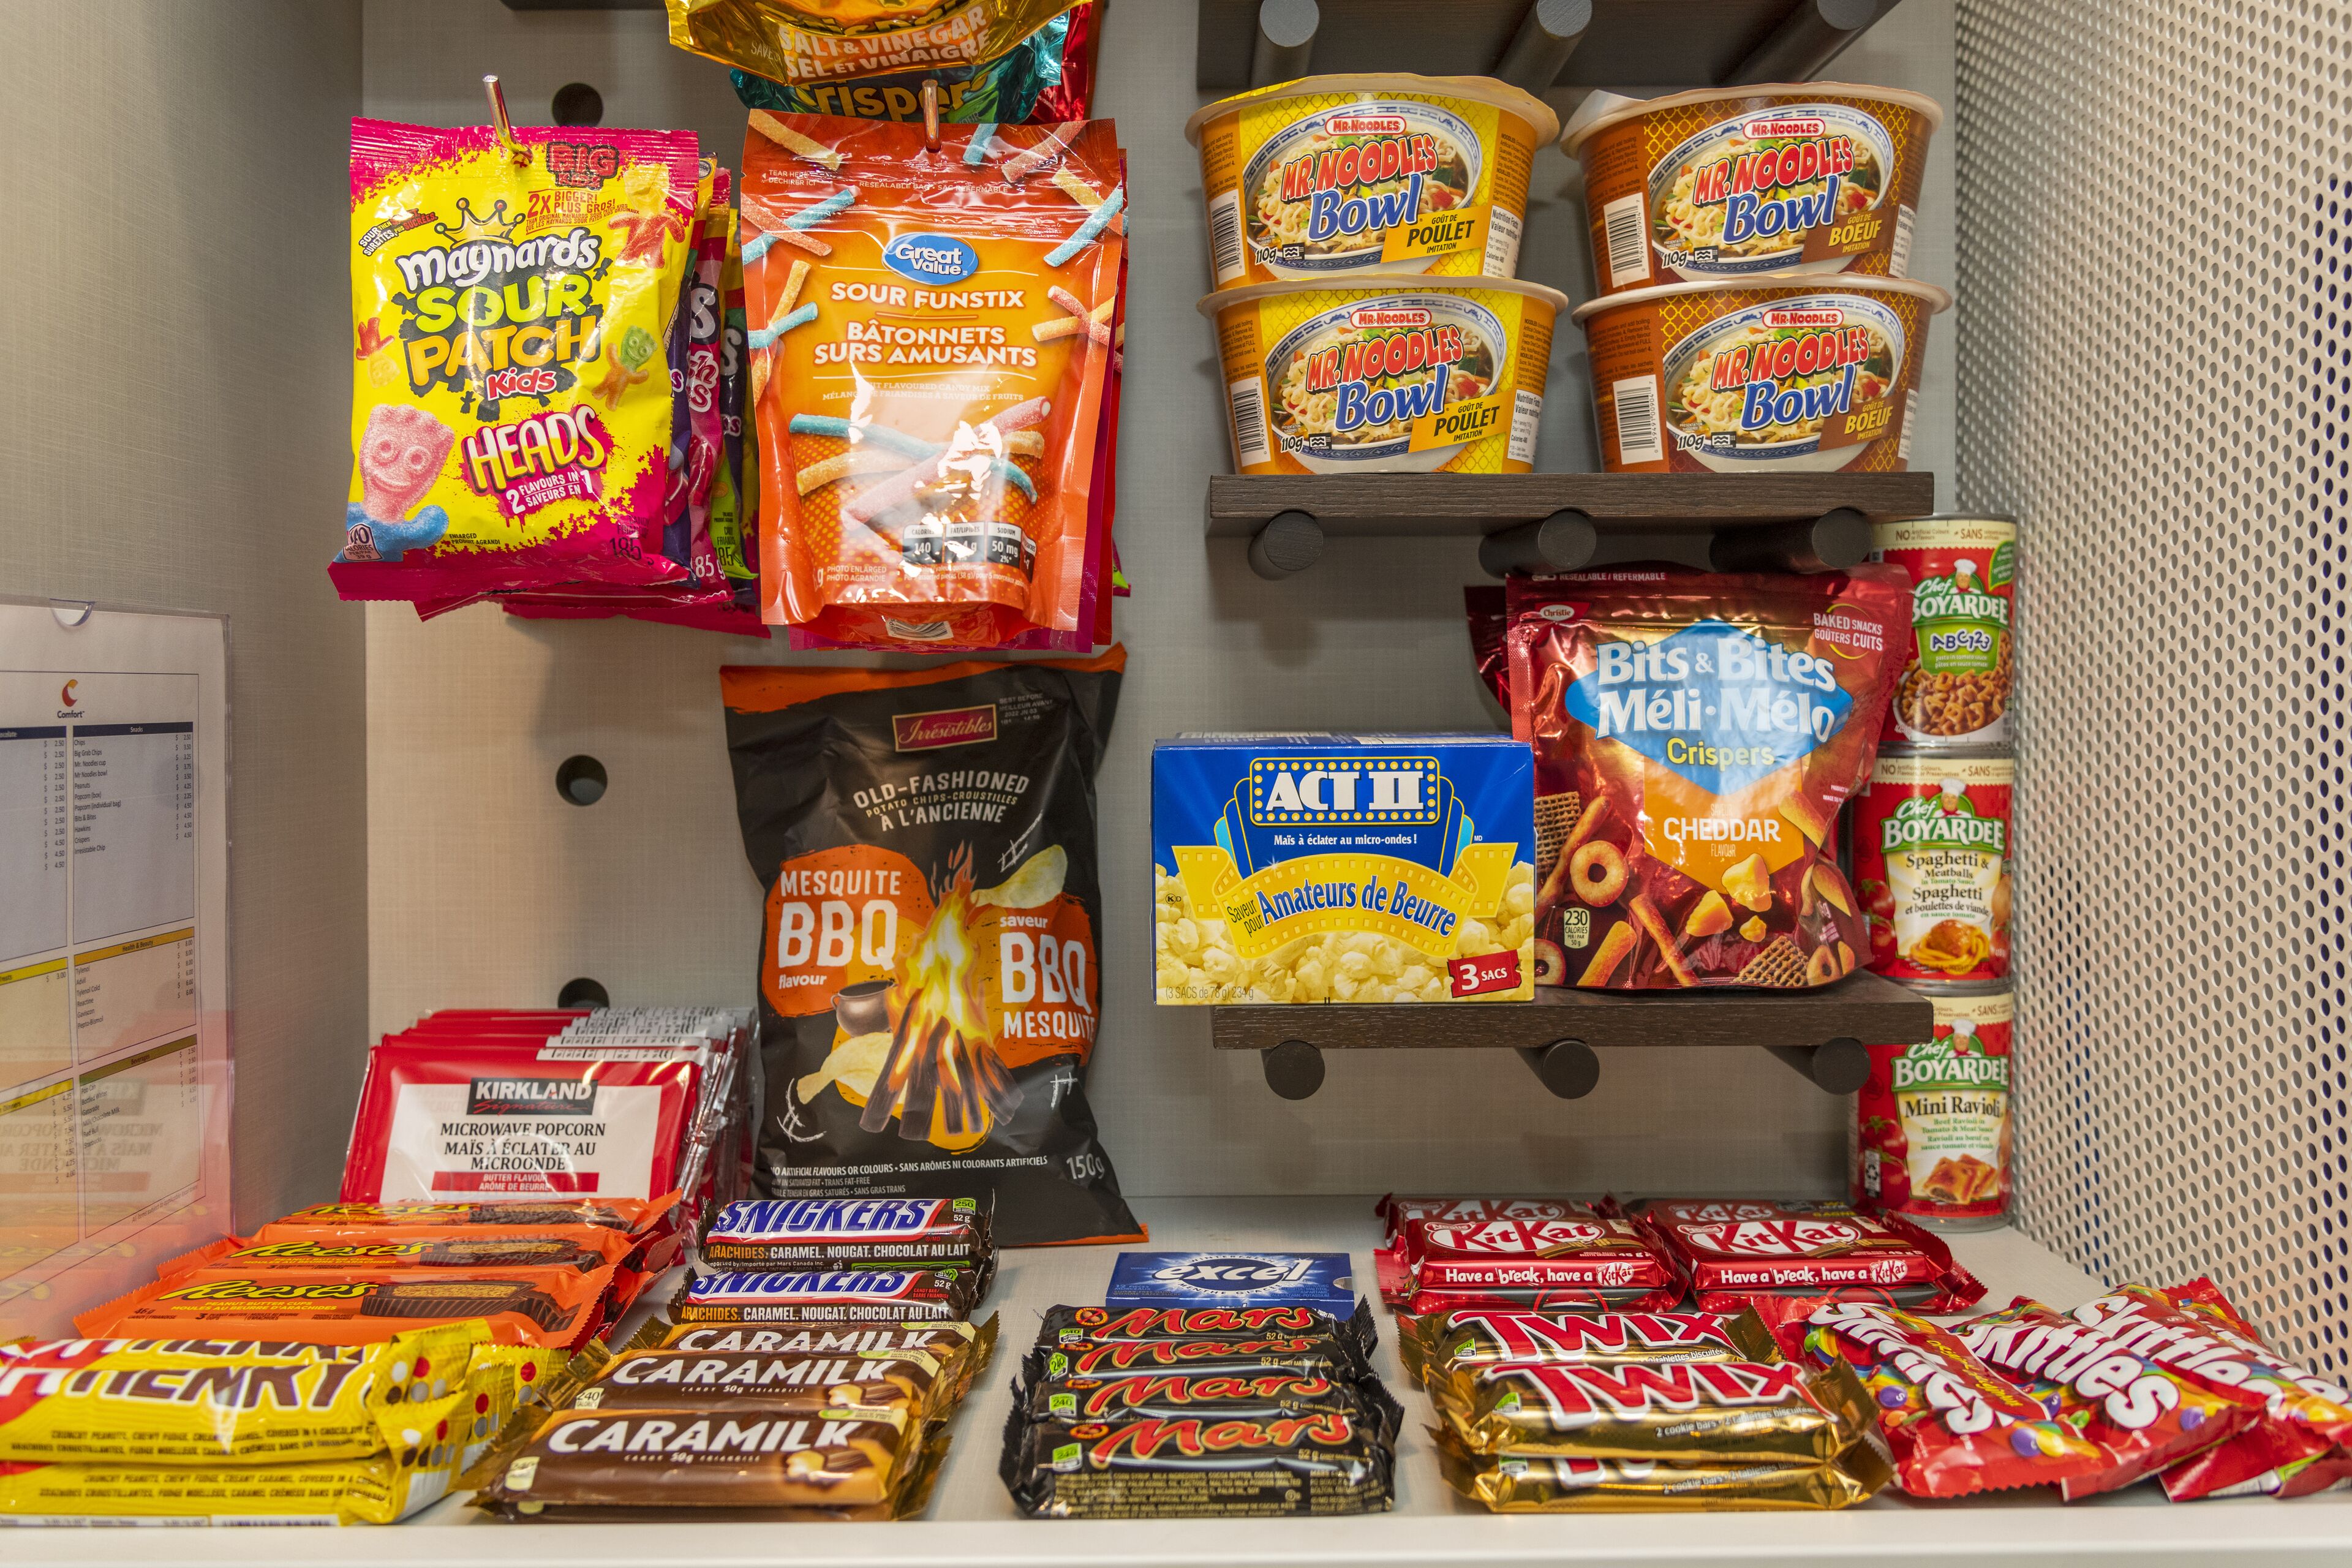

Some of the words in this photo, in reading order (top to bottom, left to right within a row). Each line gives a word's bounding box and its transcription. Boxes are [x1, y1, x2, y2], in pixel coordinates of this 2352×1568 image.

[778, 24, 839, 57] SALT
[844, 43, 859, 55] &
[860, 6, 987, 54] VINEGAR
[785, 56, 831, 78] SEL
[835, 62, 855, 73] ET
[860, 29, 990, 69] VINAIGRE
[551, 145, 618, 176] BIG
[1317, 134, 1438, 190] NOODLES
[1733, 135, 1855, 192] NOODLES
[527, 193, 551, 218] 2X
[554, 191, 597, 204] BIGGER!
[554, 202, 581, 213] PLUS
[587, 198, 615, 214] GROS!
[1309, 174, 1424, 240] Bowl
[1723, 176, 1840, 244] Bowl
[1407, 219, 1475, 248] POULET
[1828, 219, 1883, 247] BOEUF
[1847, 215, 1863, 225] GOÛT
[360, 227, 381, 247] SOUR
[1842, 241, 1869, 252] IMITATION
[895, 244, 962, 265] Great
[911, 257, 962, 276] Value
[1254, 246, 1276, 266] 110g
[416, 274, 590, 333] SOUR
[831, 282, 908, 307] SOUR
[914, 290, 1025, 309] FUNSTIX
[848, 319, 1006, 344] BÂTONNETS
[408, 315, 600, 386] PATCH
[813, 342, 881, 366] SURS
[888, 343, 1038, 367] AMUSANTS
[1342, 324, 1463, 382] NOODLES
[1750, 325, 1870, 380] NOODLES
[488, 367, 556, 398] Kids
[1335, 365, 1448, 431] Bowl
[1741, 364, 1856, 431] Bowl
[1434, 406, 1500, 437] POULET
[1845, 410, 1893, 434] BOEUF
[466, 404, 607, 492] HEADS
[1453, 430, 1483, 442] IMITATION
[519, 474, 565, 496] FLAVOURS
[567, 470, 579, 483] IN
[526, 487, 566, 507] SAVEURS
[568, 484, 581, 497] EN
[1913, 595, 2008, 625] BOYARDEE
[1814, 613, 1850, 630] BAKED
[1852, 620, 1882, 635] SNACKS
[1815, 628, 1850, 644] GOÛTERS
[1853, 633, 1883, 651] CUITS
[1597, 639, 1687, 685] Bits
[1694, 652, 1714, 673] &
[1716, 638, 1836, 692] Bites
[57, 710, 83, 718] Comfort
[1666, 737, 1774, 771] Crispers
[853, 771, 1029, 809] OLD-FASHIONED
[1265, 771, 1360, 811] ACT
[1368, 771, 1423, 810] II
[866, 799, 907, 818] POTATO
[881, 813, 894, 831] À
[899, 802, 1006, 827] L'ANCIENNE
[1896, 799, 1936, 819] Chef
[1274, 834, 1295, 845] Maïs
[1298, 834, 1305, 845] à
[1307, 834, 1337, 845] éclater
[1355, 834, 1412, 845] micro-ondes
[1664, 817, 1781, 843] CHEDDAR
[1884, 817, 2005, 849] BOYARDEE
[1907, 851, 1978, 870] Spaghetti
[1925, 869, 1973, 878] Meatballs
[779, 869, 902, 898] MESQUITE
[1913, 884, 1983, 903] Spaghetti
[1226, 897, 1257, 925] Saveur
[1255, 878, 1357, 927] Amateurs
[1361, 875, 1387, 911] de
[1389, 880, 1457, 937] Beurre
[777, 899, 899, 971] BBQ
[999, 914, 1049, 929] saveur
[1243, 915, 1265, 939] pour
[778, 973, 827, 989] flavour
[998, 931, 1091, 1016] BBQ
[1460, 963, 1479, 990] 3
[1481, 966, 1507, 981] SACS
[1003, 1011, 1096, 1042] MESQUITE
[1894, 1057, 2008, 1087] BOYARDEE
[475, 1080, 593, 1101] KIRKLAND
[1905, 1096, 1947, 1118] Mini
[1952, 1097, 2000, 1117] Ravioli
[440, 1122, 531, 1137] MICROWAVE
[535, 1123, 606, 1137] POPCORN
[445, 1140, 483, 1156] MAÏS
[486, 1139, 500, 1155] À
[502, 1139, 570, 1156] ÉCLATER
[574, 1142, 596, 1156] AU
[471, 1156, 566, 1170] MICROONDE
[782, 1165, 812, 1177] ARTIFICIAL
[813, 1164, 847, 1177] FLAVOURS
[859, 1164, 893, 1175] COLOURS
[899, 1162, 918, 1172] SANS
[921, 1160, 952, 1171] ARÔMES
[963, 1158, 1005, 1169] COLORANTS
[1006, 1155, 1047, 1168] ARTIFICIELS
[1066, 1153, 1104, 1180] 150g
[710, 1199, 937, 1234] SNICKERS
[233, 1240, 435, 1257] Reese's
[1455, 1221, 1594, 1252] KitKat
[1709, 1221, 1852, 1253] KitKat
[771, 1245, 824, 1258] CARAMEL.
[827, 1245, 871, 1257] NOUGAT.
[873, 1245, 929, 1257] CHOCOLAT
[932, 1245, 945, 1256] AU
[948, 1243, 970, 1256] LAIT
[1152, 1259, 1317, 1281] excel
[1446, 1268, 1481, 1283] Have
[1485, 1272, 1493, 1281] a
[1547, 1268, 1581, 1282] have
[1584, 1272, 1593, 1281] a
[159, 1280, 380, 1300] Reese's
[1091, 1306, 1314, 1340] Mars
[1449, 1311, 1746, 1362] TWIX
[613, 1355, 897, 1385] CARAMILK
[1084, 1376, 1330, 1415] Mars
[1485, 1362, 1837, 1430] TWIX
[548, 1419, 862, 1453] CARAMILK
[1090, 1414, 1352, 1468] Mars
